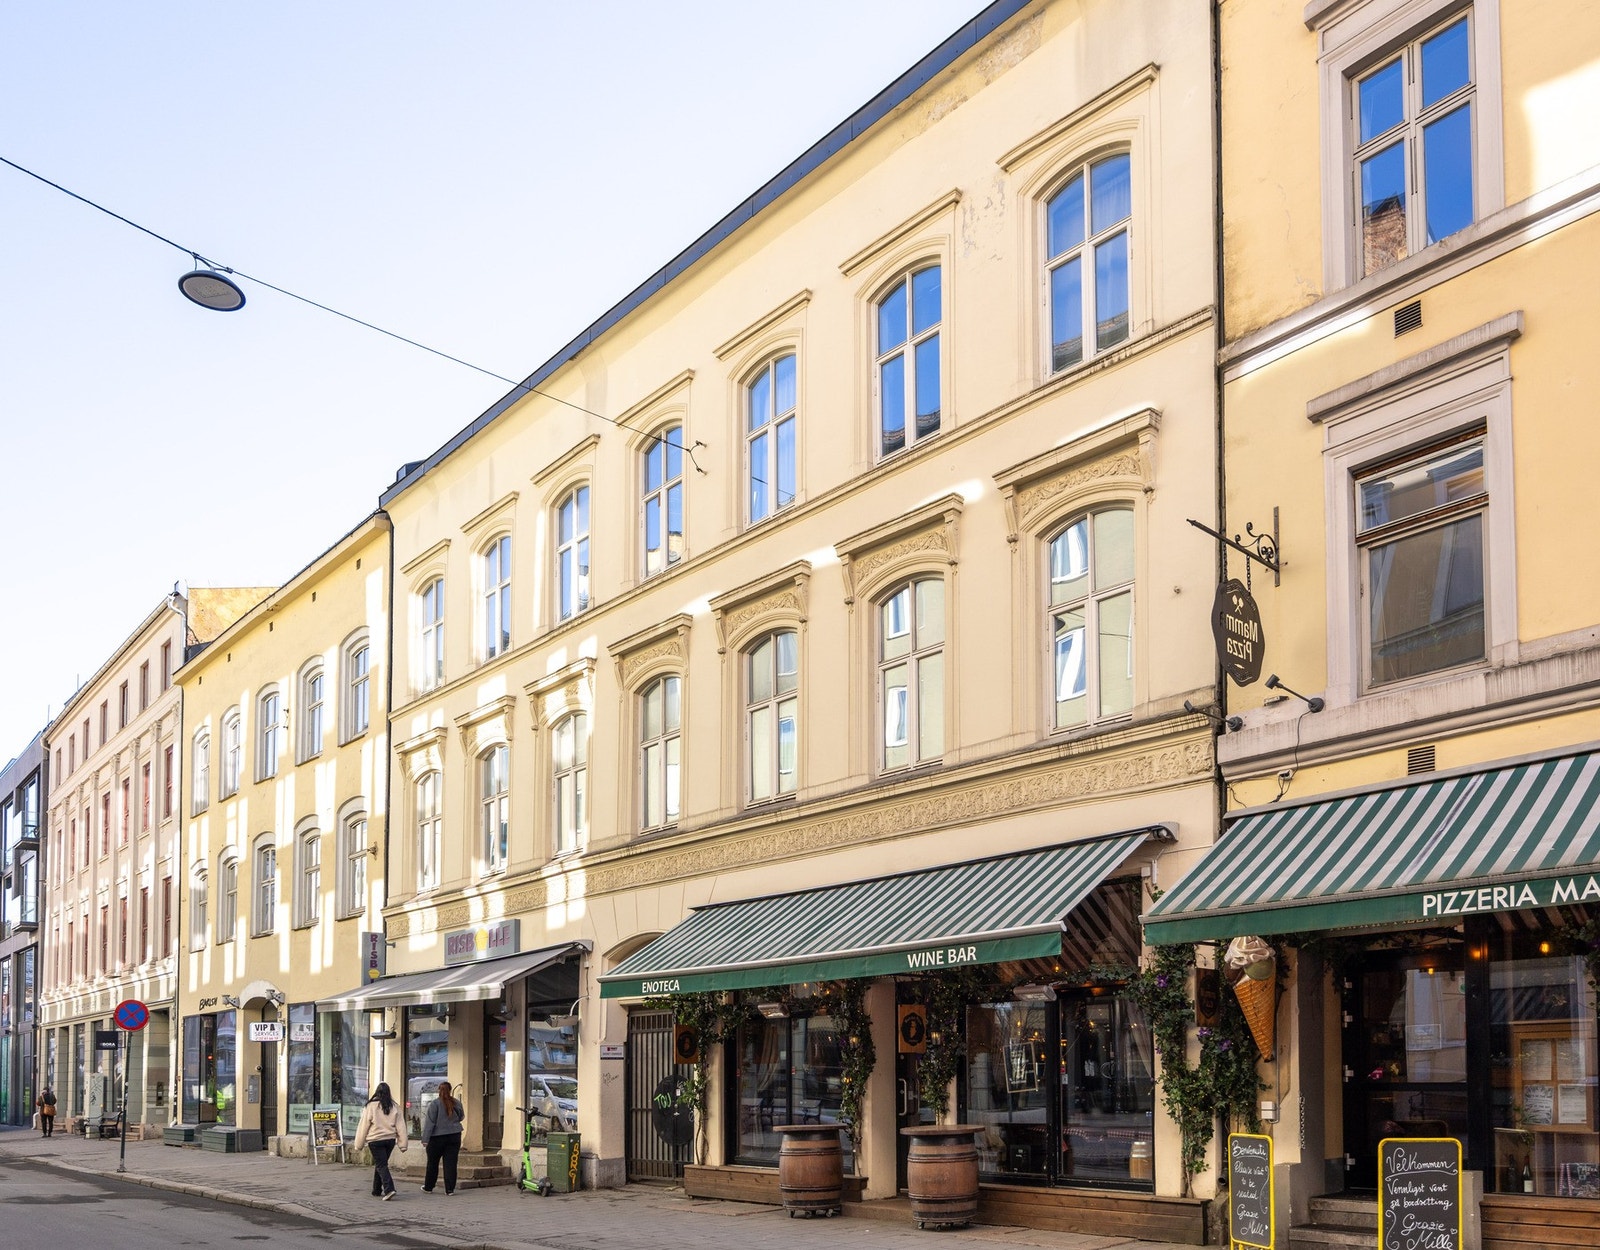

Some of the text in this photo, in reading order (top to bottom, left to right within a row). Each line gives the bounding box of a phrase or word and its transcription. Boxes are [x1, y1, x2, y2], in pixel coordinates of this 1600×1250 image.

[1423, 884, 1538, 916] PIZZERIA
[907, 946, 977, 968] WINE BAR
[642, 980, 680, 993] ENOTECA
[1387, 1179, 1448, 1197] Vennligst vent
[1236, 1203, 1259, 1220] Grazie
[1390, 1198, 1400, 1210] på
[1401, 1213, 1446, 1236] Grazie
[1406, 1230, 1454, 1250] Mille
